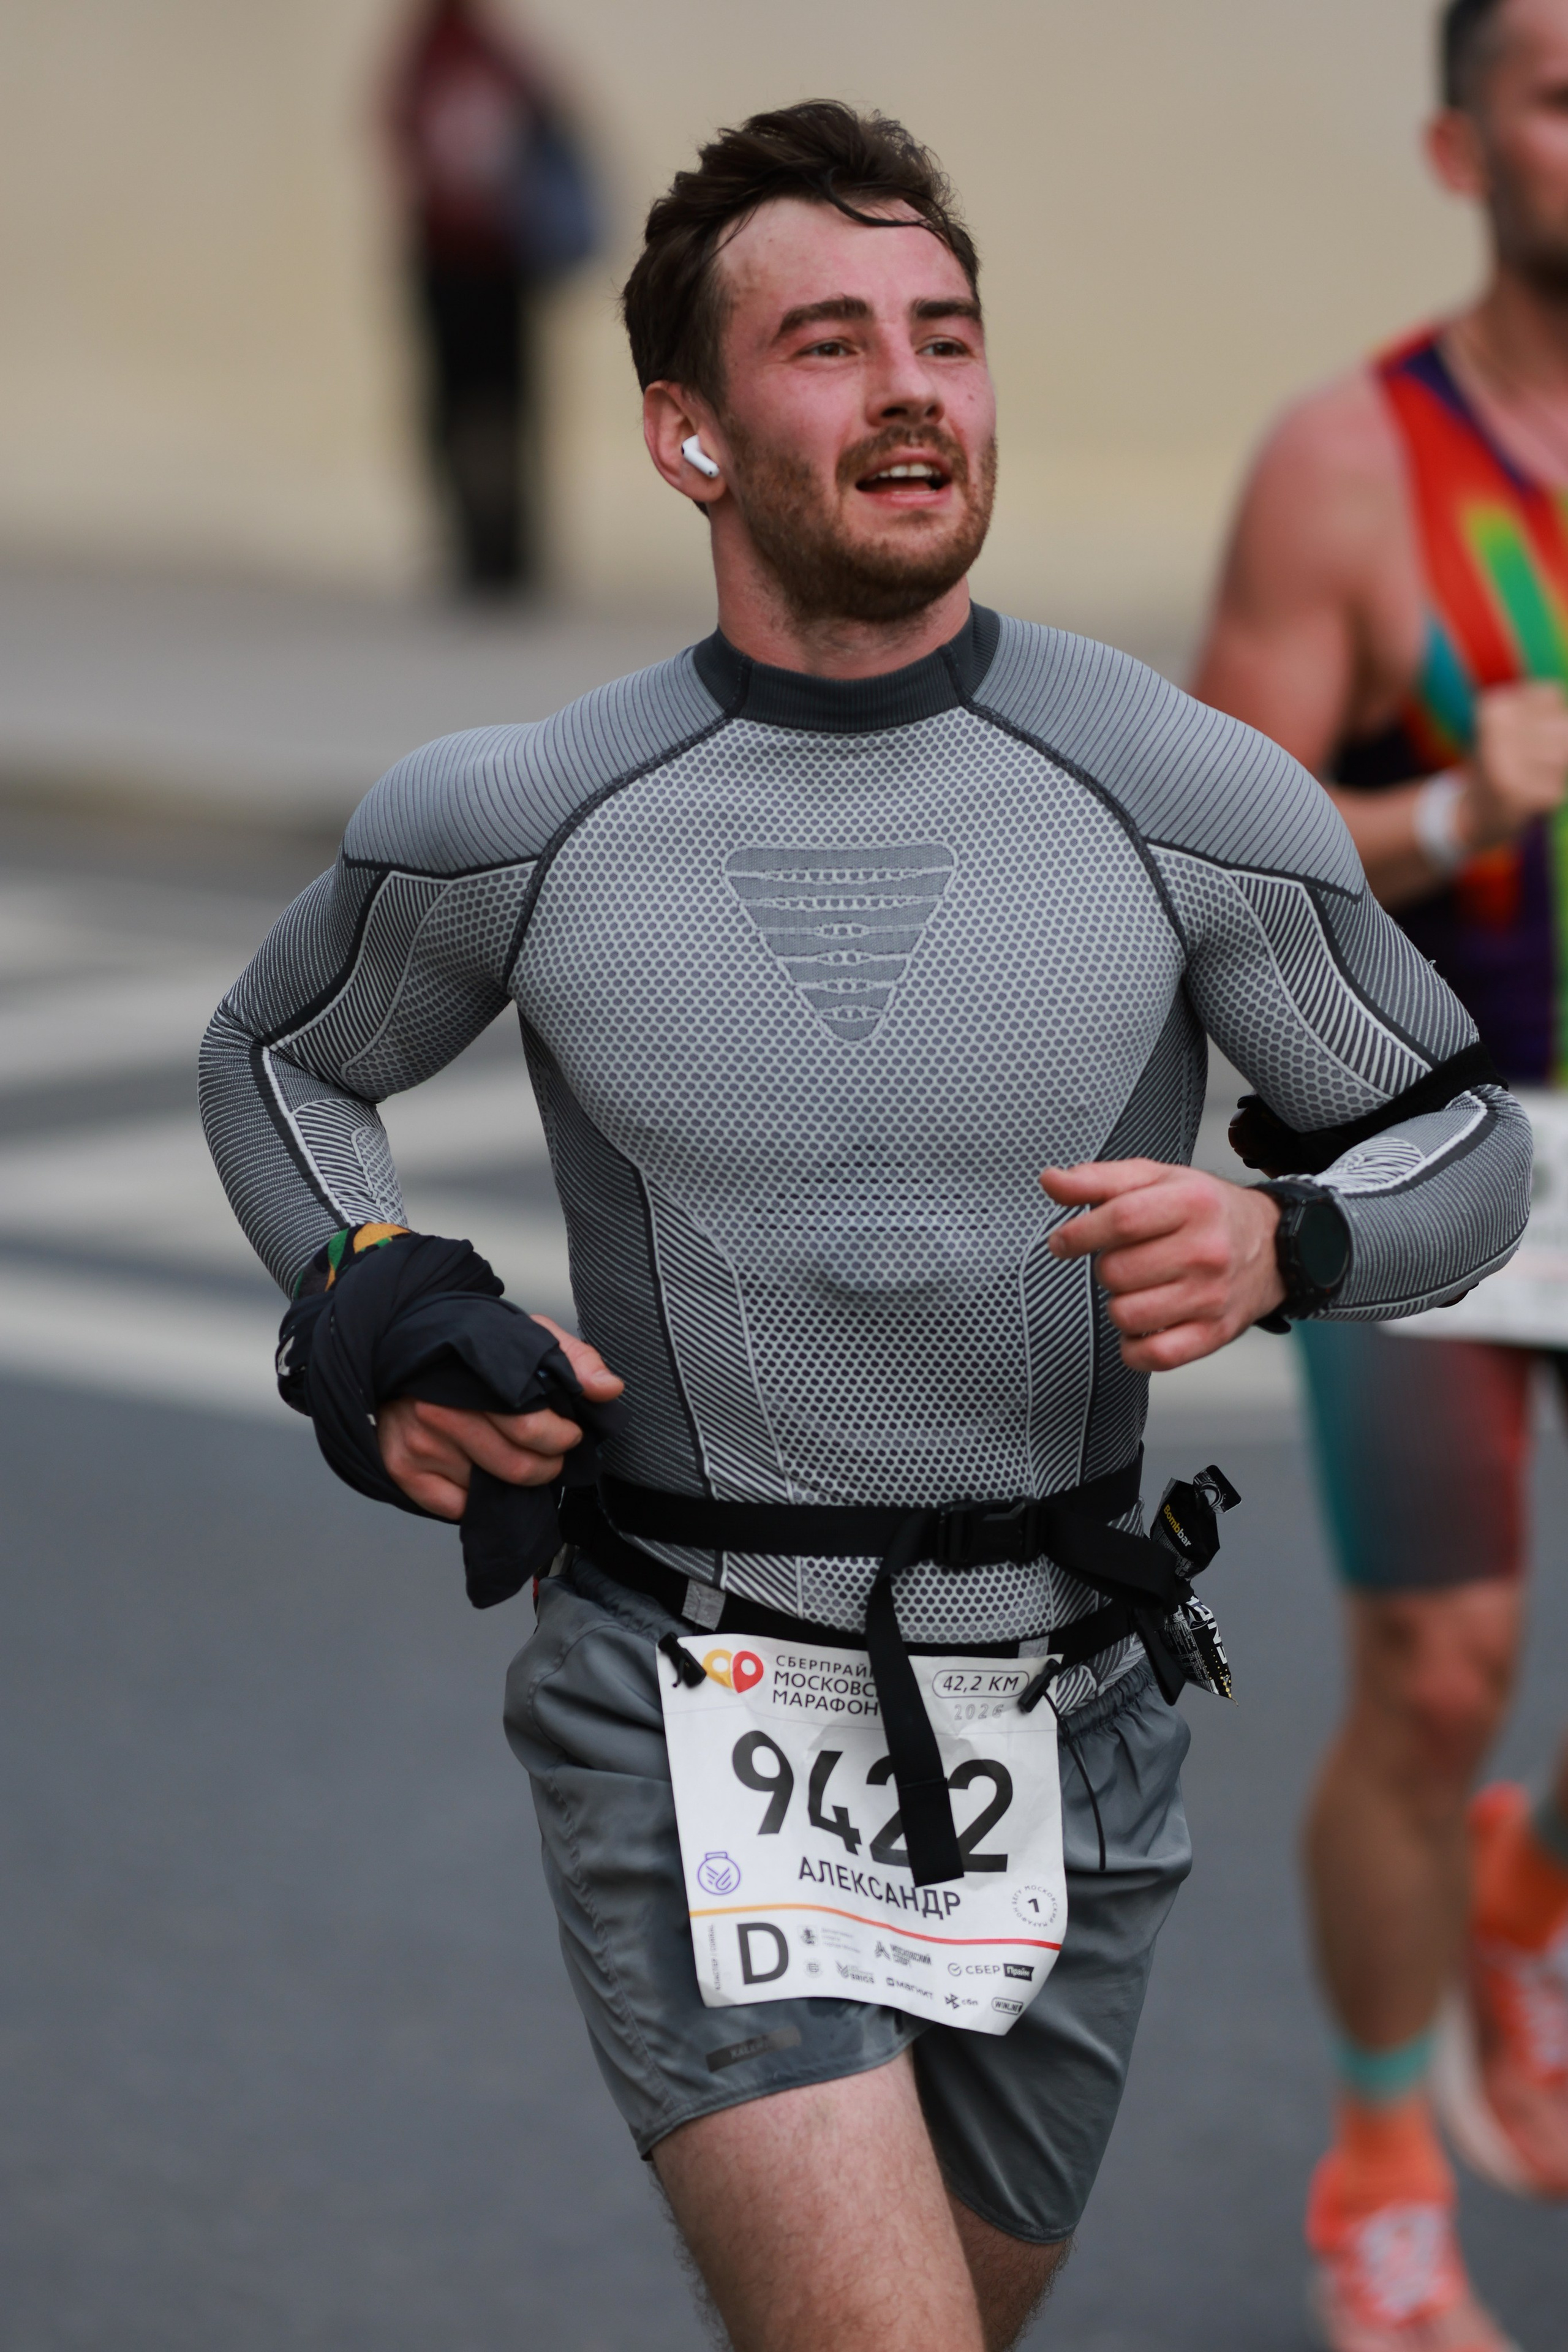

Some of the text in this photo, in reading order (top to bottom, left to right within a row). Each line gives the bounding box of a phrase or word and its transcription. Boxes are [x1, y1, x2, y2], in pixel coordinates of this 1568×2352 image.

[1164, 1504, 1191, 1547] Bombbar
[776, 1655, 873, 1678] СБЕРПРАЙ
[774, 1671, 877, 1697] МОСКОВС
[943, 1676, 1019, 1692] 42,2 КМ
[773, 1690, 878, 1716] МАРАФОН
[799, 1856, 960, 1920] АЛЕКСАНДР
[1027, 1899, 1039, 1913] 1
[737, 1922, 789, 1985] D
[965, 1965, 1030, 1978] СБЕР Прайм
